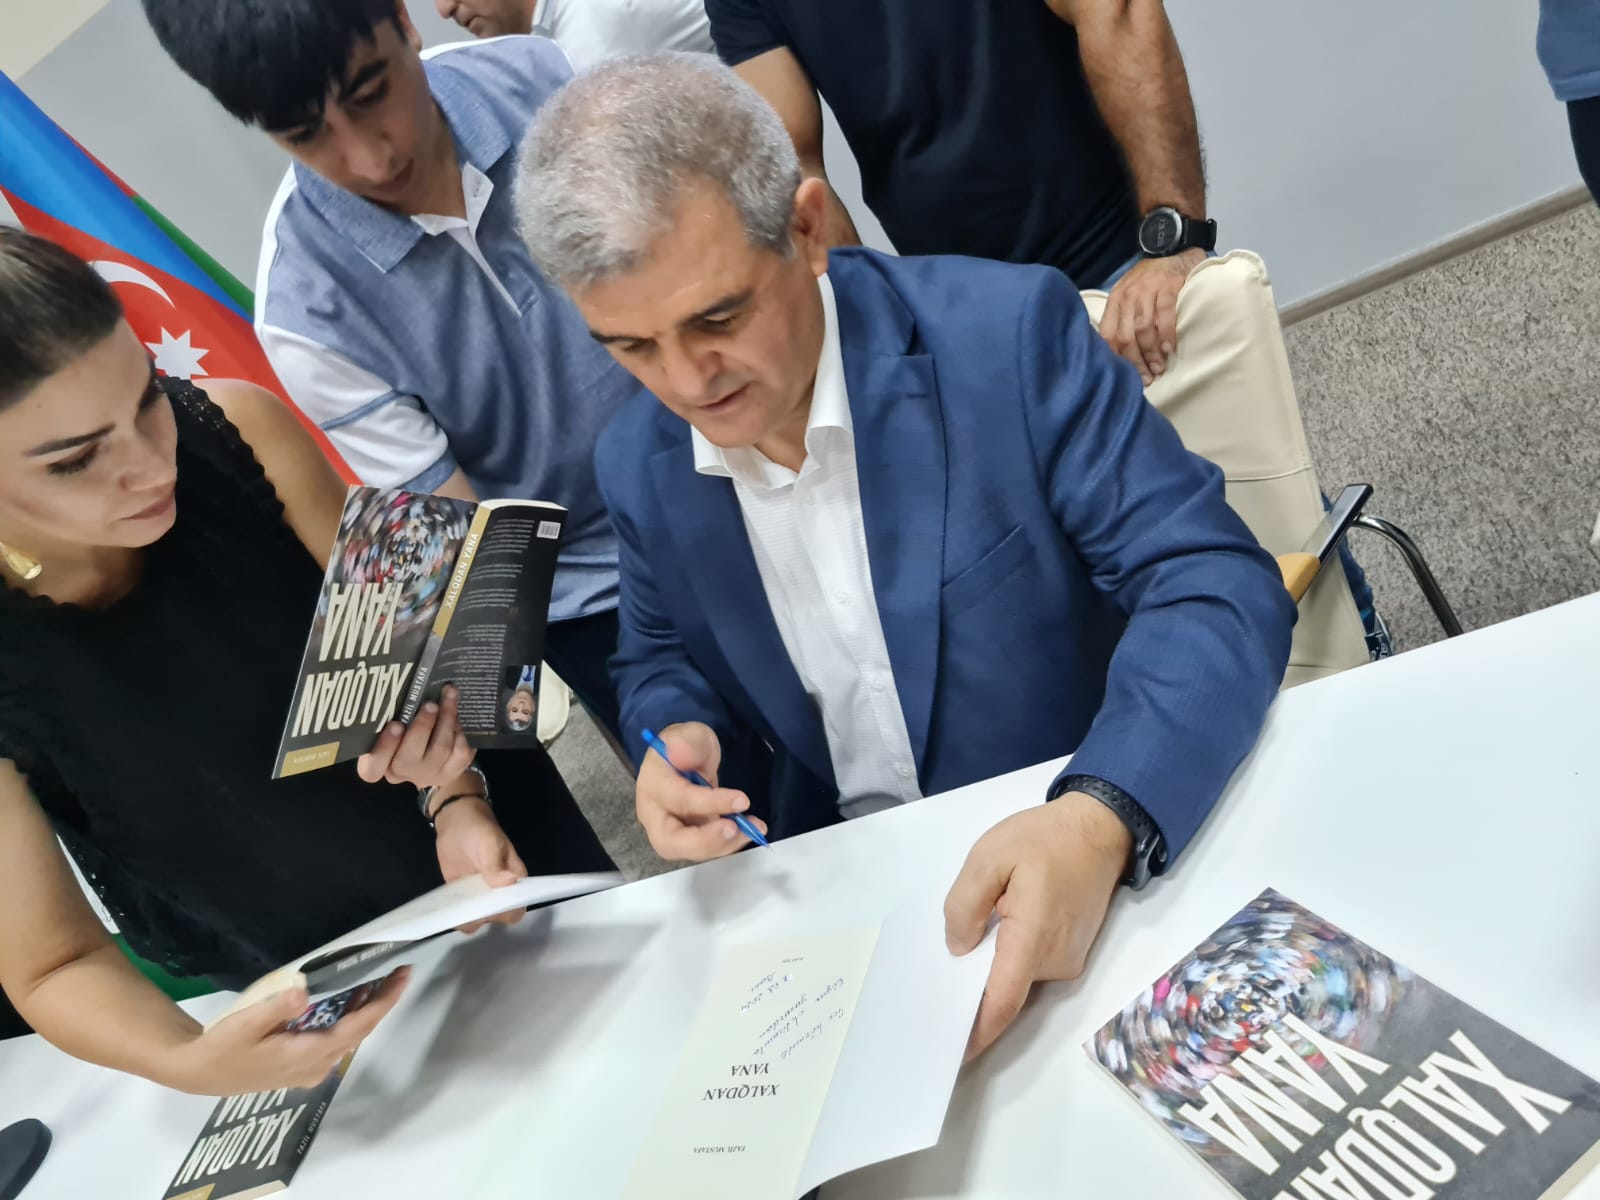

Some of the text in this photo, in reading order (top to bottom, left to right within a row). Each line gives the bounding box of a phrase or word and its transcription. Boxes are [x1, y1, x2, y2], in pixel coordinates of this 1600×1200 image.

[444, 532, 479, 610] XALQDAN YANA
[318, 583, 404, 662] YANA
[291, 661, 414, 738] XALQDAN
[409, 667, 429, 702] MUSTAFA
[702, 1083, 780, 1101] XALQDAN
[731, 1063, 770, 1077] YANA
[1177, 1012, 1392, 1176] YANA
[174, 1103, 307, 1187] XALQDAN
[693, 1145, 726, 1153] MUSTAFA
[1272, 1029, 1573, 1200] XALQDA
